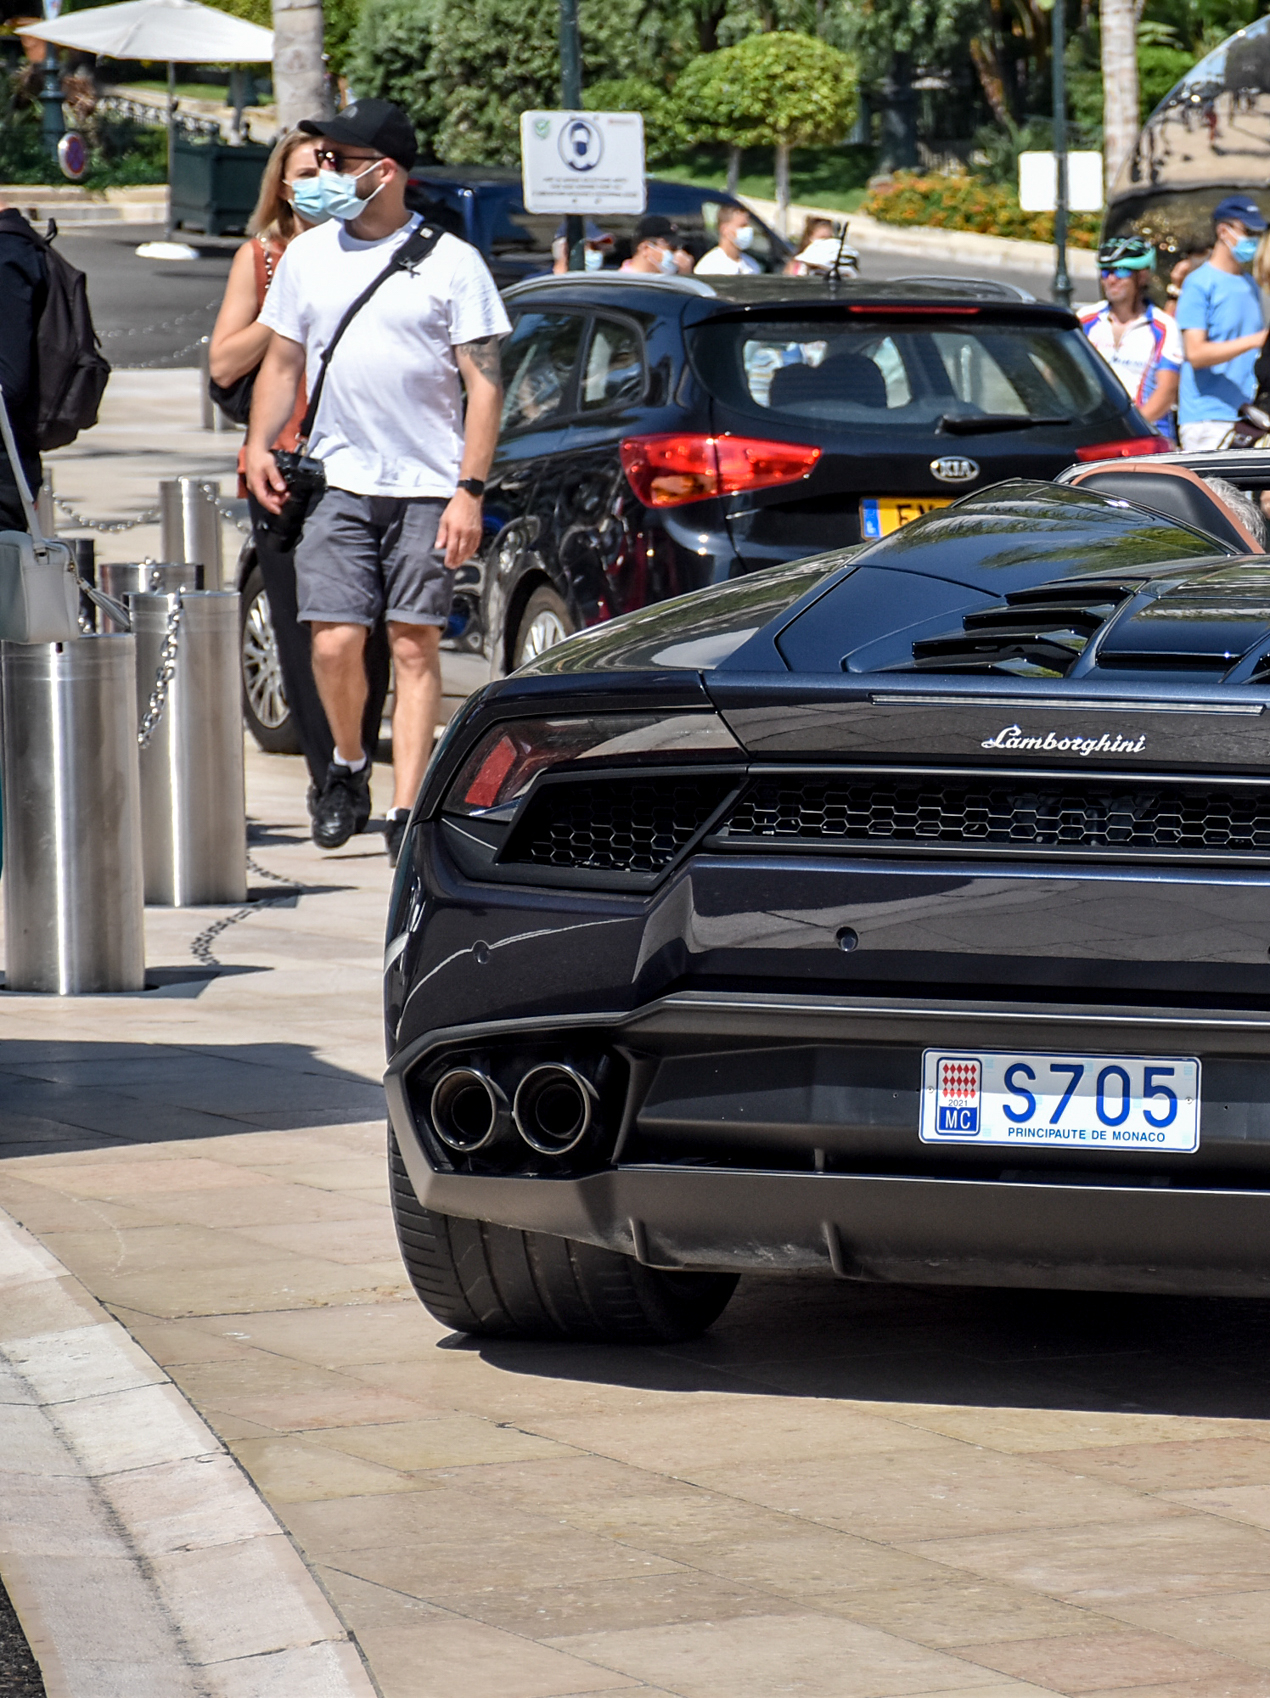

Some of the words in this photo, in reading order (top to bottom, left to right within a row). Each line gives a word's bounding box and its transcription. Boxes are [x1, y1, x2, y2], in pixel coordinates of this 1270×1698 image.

[940, 461, 971, 477] KIA
[981, 724, 1146, 756] Lamborghini
[948, 1099, 968, 1107] 2021
[1002, 1062, 1178, 1128] S705
[945, 1110, 971, 1130] MC
[1008, 1127, 1086, 1140] PRINCIPAUTE
[1091, 1130, 1107, 1140] DE
[1112, 1131, 1165, 1142] MONACO
